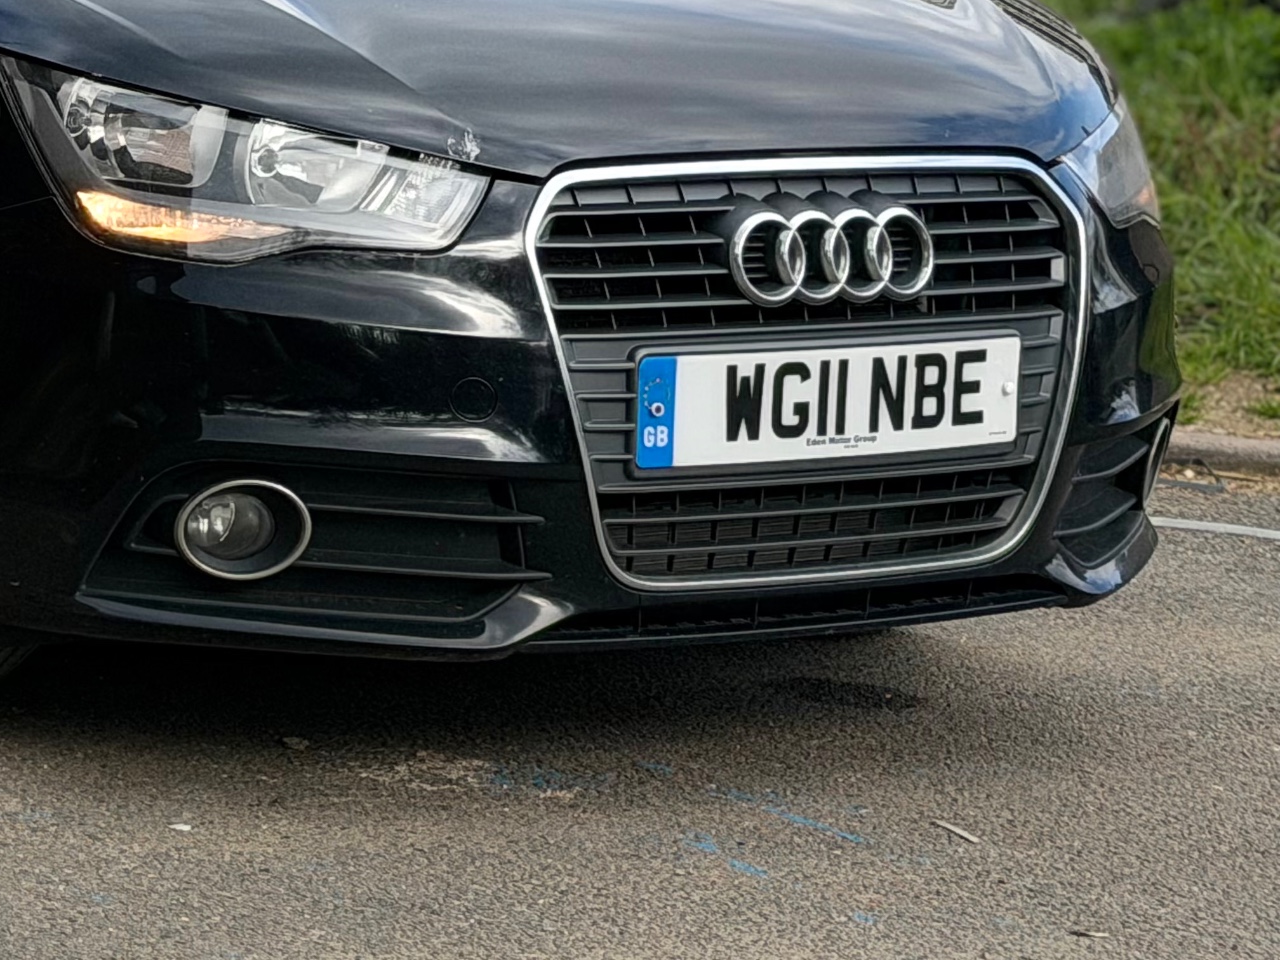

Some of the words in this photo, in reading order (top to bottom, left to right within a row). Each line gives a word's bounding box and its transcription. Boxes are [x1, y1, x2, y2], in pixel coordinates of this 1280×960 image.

[726, 359, 849, 442] WG11
[869, 349, 987, 433] NBE
[643, 425, 669, 448] GB
[853, 434, 878, 444] Group
